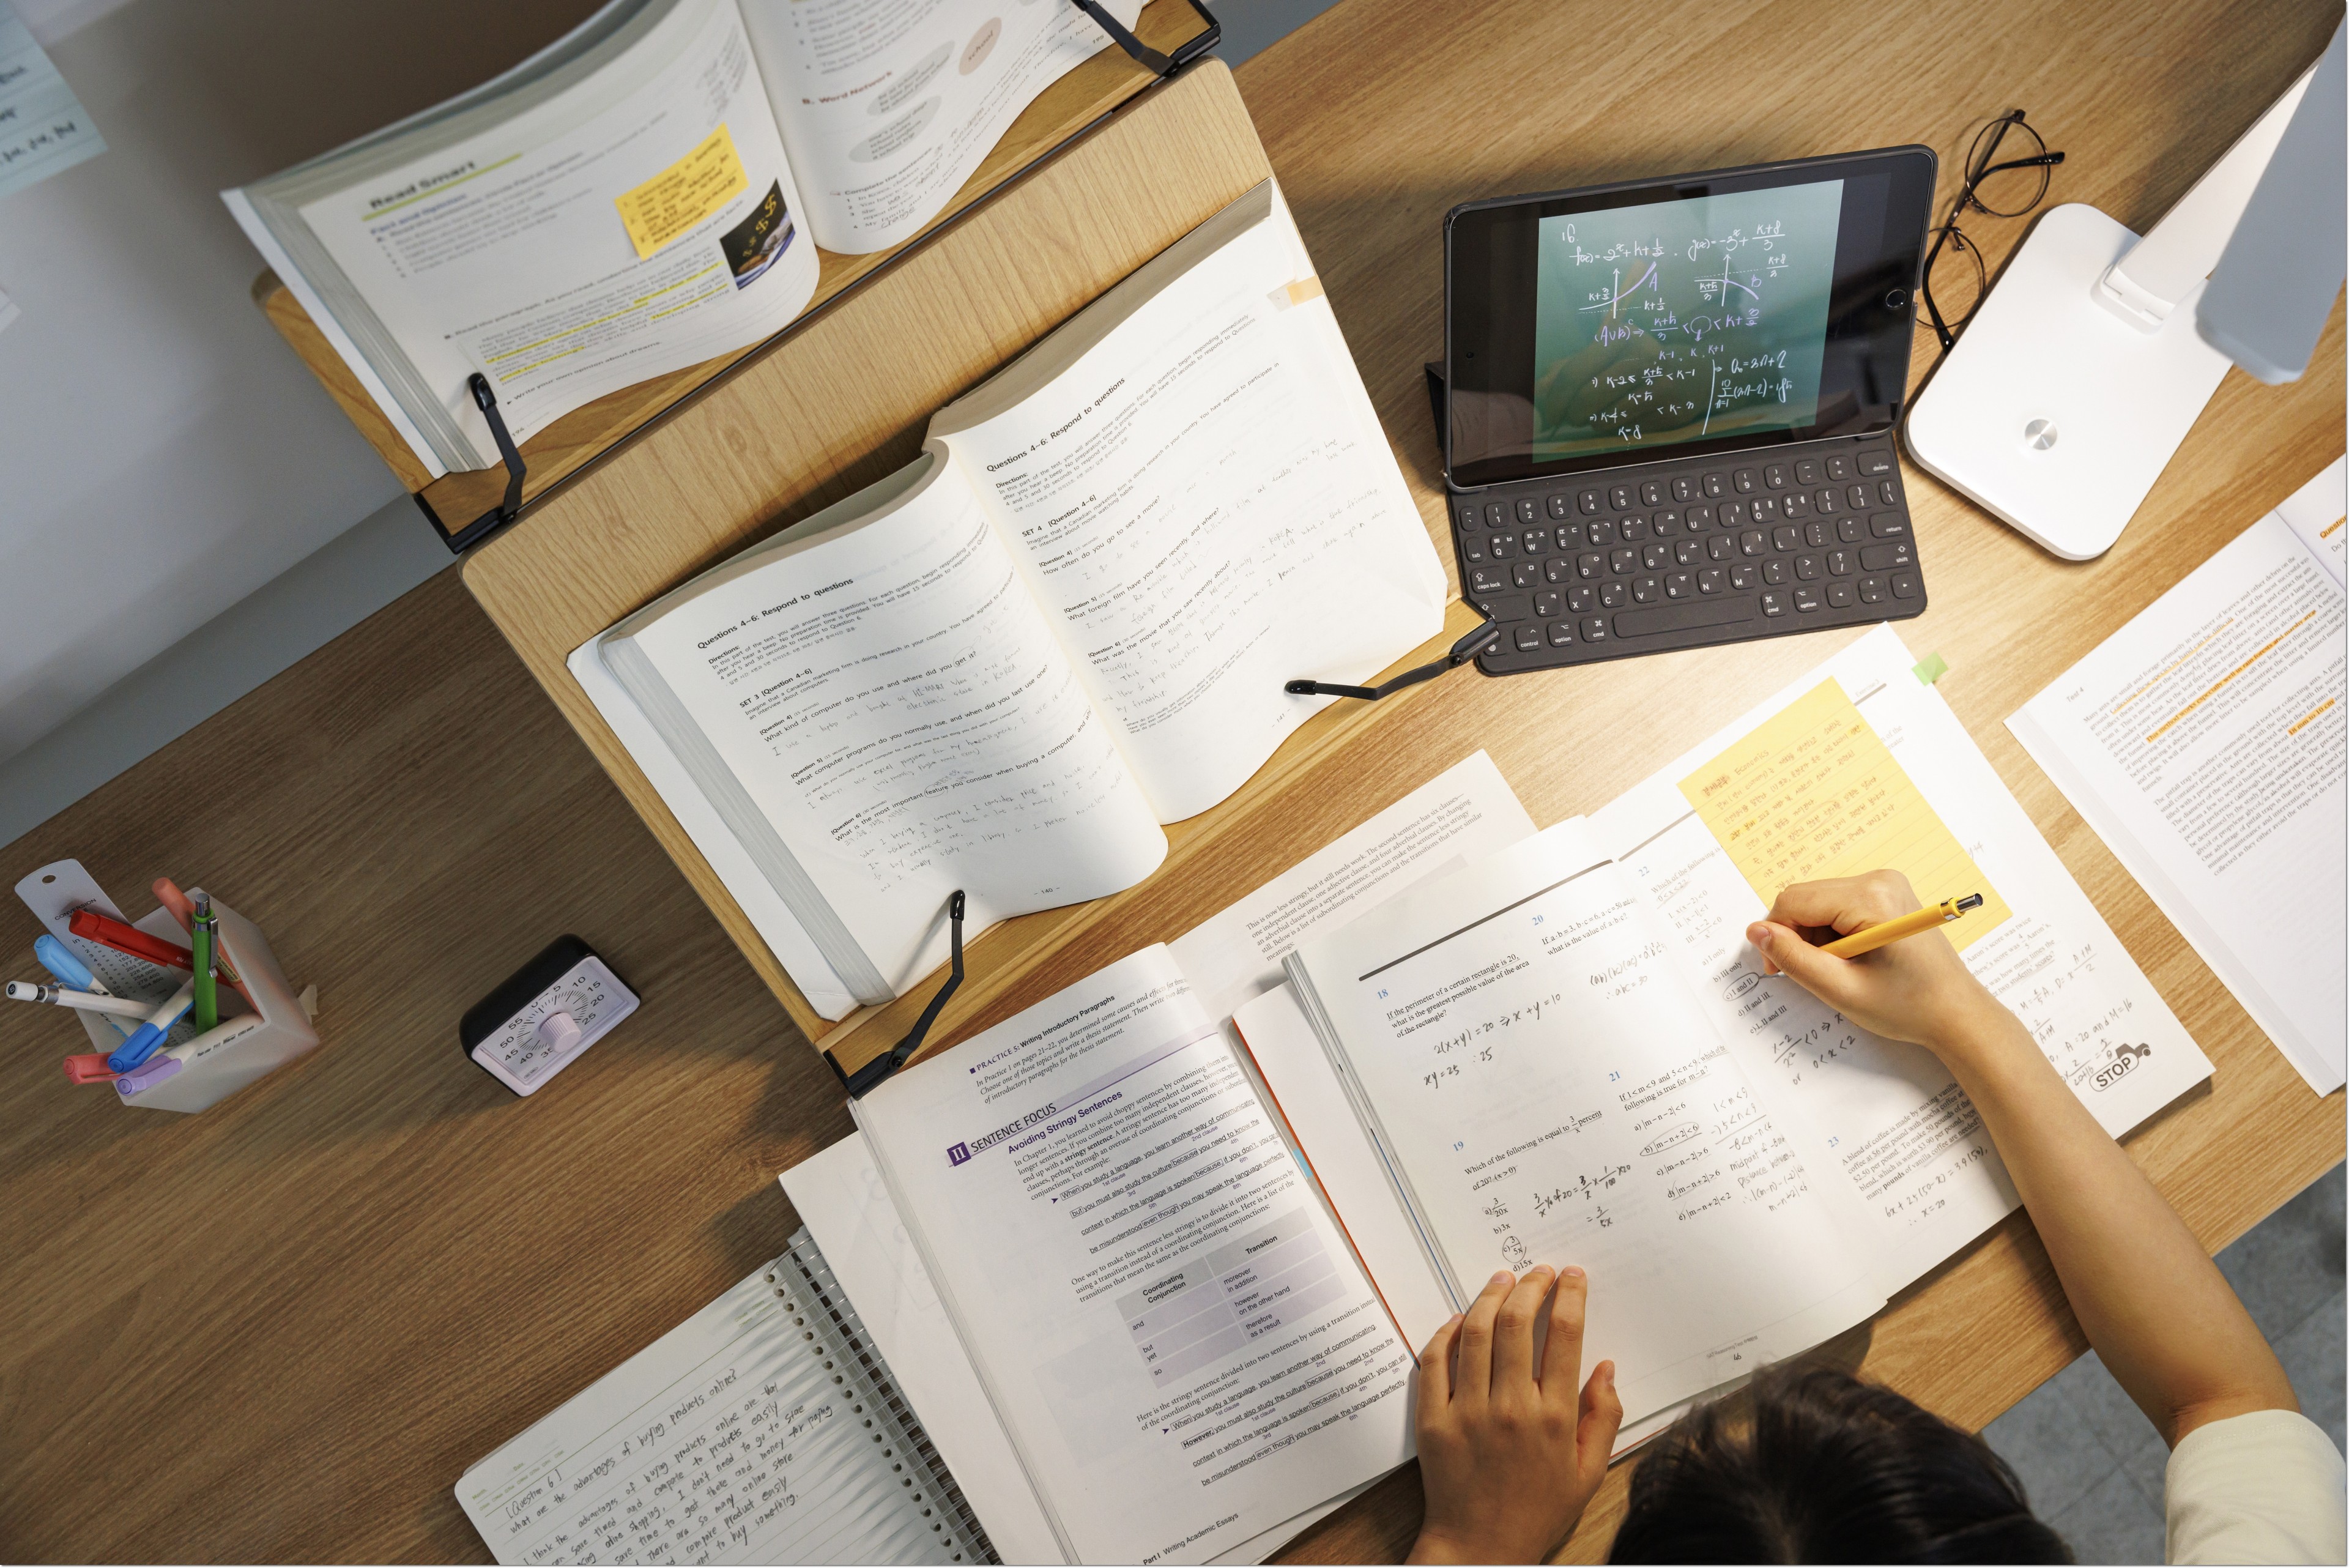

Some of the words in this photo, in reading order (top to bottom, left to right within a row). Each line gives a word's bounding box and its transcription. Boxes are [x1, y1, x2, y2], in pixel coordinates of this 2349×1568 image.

[967, 29, 995, 62] school
[819, 91, 848, 104] Word
[850, 71, 892, 94] Network
[369, 184, 417, 209] Read
[418, 160, 475, 188] Smart
[986, 451, 1028, 472] Questions
[1030, 438, 1048, 451] 4~6:
[1050, 412, 1082, 440] Respond
[1084, 406, 1092, 415] to
[1094, 377, 1125, 406] questions
[995, 472, 1028, 489] Directions:
[1022, 528, 1034, 537] SET
[1048, 507, 1080, 527] [Question
[1082, 494, 1097, 507] 4~6]
[1042, 567, 1059, 576] How
[1061, 558, 1079, 568] often
[1092, 543, 1105, 554] you
[1106, 535, 1115, 544] go
[1125, 519, 1135, 529] see
[1142, 496, 1159, 515] movie?
[697, 626, 738, 649] Questions
[741, 615, 760, 626] 4~6:
[761, 597, 798, 617] Respond
[814, 579, 854, 596] questions
[708, 645, 740, 664] Directions:
[740, 697, 752, 708] SET
[761, 677, 794, 697] [Question
[796, 668, 813, 678] 4~6]
[763, 730, 783, 742] What
[784, 720, 799, 732] kind
[811, 700, 842, 718] computer
[856, 691, 870, 699] you
[886, 680, 900, 688] and
[902, 674, 923, 683] where
[939, 663, 952, 673] you
[953, 657, 967, 667] get
[1734, 749, 1770, 776] Economics
[1638, 866, 1650, 877] 22
[1245, 920, 1260, 930] This
[1265, 908, 1278, 920] now
[1276, 902, 1288, 912] less
[1288, 890, 1310, 905] stringy,
[1307, 883, 1319, 893] but
[1324, 872, 1335, 883] still
[1334, 863, 1351, 877] needs
[1350, 853, 1367, 866] work.
[54, 898, 97, 921] CONVERSION
[1532, 915, 1544, 926] 20
[573, 976, 586, 987] 10
[587, 981, 601, 992] 15
[1405, 993, 1434, 1013] perimeter
[1436, 987, 1443, 997] of
[1449, 976, 1471, 990] certain
[1471, 962, 1500, 981] rectangle
[1507, 954, 1520, 963] 20,
[591, 994, 604, 1007] 20
[1376, 989, 1389, 1000] 18
[508, 1017, 523, 1030] 55
[582, 1013, 596, 1025] 25
[500, 1036, 514, 1049] 50
[976, 1048, 1013, 1071] PRACTICE
[1019, 1034, 1043, 1048] Writing
[1042, 1014, 1079, 1036] Introductory
[1078, 995, 1115, 1017] Paragraphs
[505, 1049, 519, 1061] 45
[520, 1052, 533, 1065] 40
[1609, 1071, 1621, 1082] 21
[2096, 1057, 2131, 1087] STOP
[970, 1120, 1023, 1153] SENTENCE
[1023, 1102, 1056, 1126] FOCUS
[1008, 1131, 1047, 1154] Avoiding
[1046, 1114, 1077, 1134] Stringy
[1077, 1091, 1123, 1118] Sentences
[1452, 1141, 1464, 1152] 19
[1827, 1136, 1839, 1148] 23
[1729, 1150, 1759, 1172] midpoint
[1245, 1236, 1278, 1255] Transition
[1142, 1273, 1184, 1296] Coordinating
[1223, 1268, 1251, 1285] moreover
[1234, 1275, 1258, 1290] addition
[1148, 1282, 1186, 1303] Conjunction
[1234, 1291, 1259, 1307] however
[1258, 1295, 1274, 1306] other
[1274, 1285, 1291, 1298] hand
[1132, 1320, 1145, 1331] and
[1245, 1313, 1273, 1330] therefore
[1263, 1318, 1282, 1331] result
[1142, 1343, 1154, 1353] but
[1146, 1352, 1157, 1362] yet
[1143, 1554, 1157, 1565] Part
[1162, 1540, 1186, 1555] Writing
[1186, 1525, 1216, 1544] Academic
[1215, 1513, 1239, 1528] Essays
